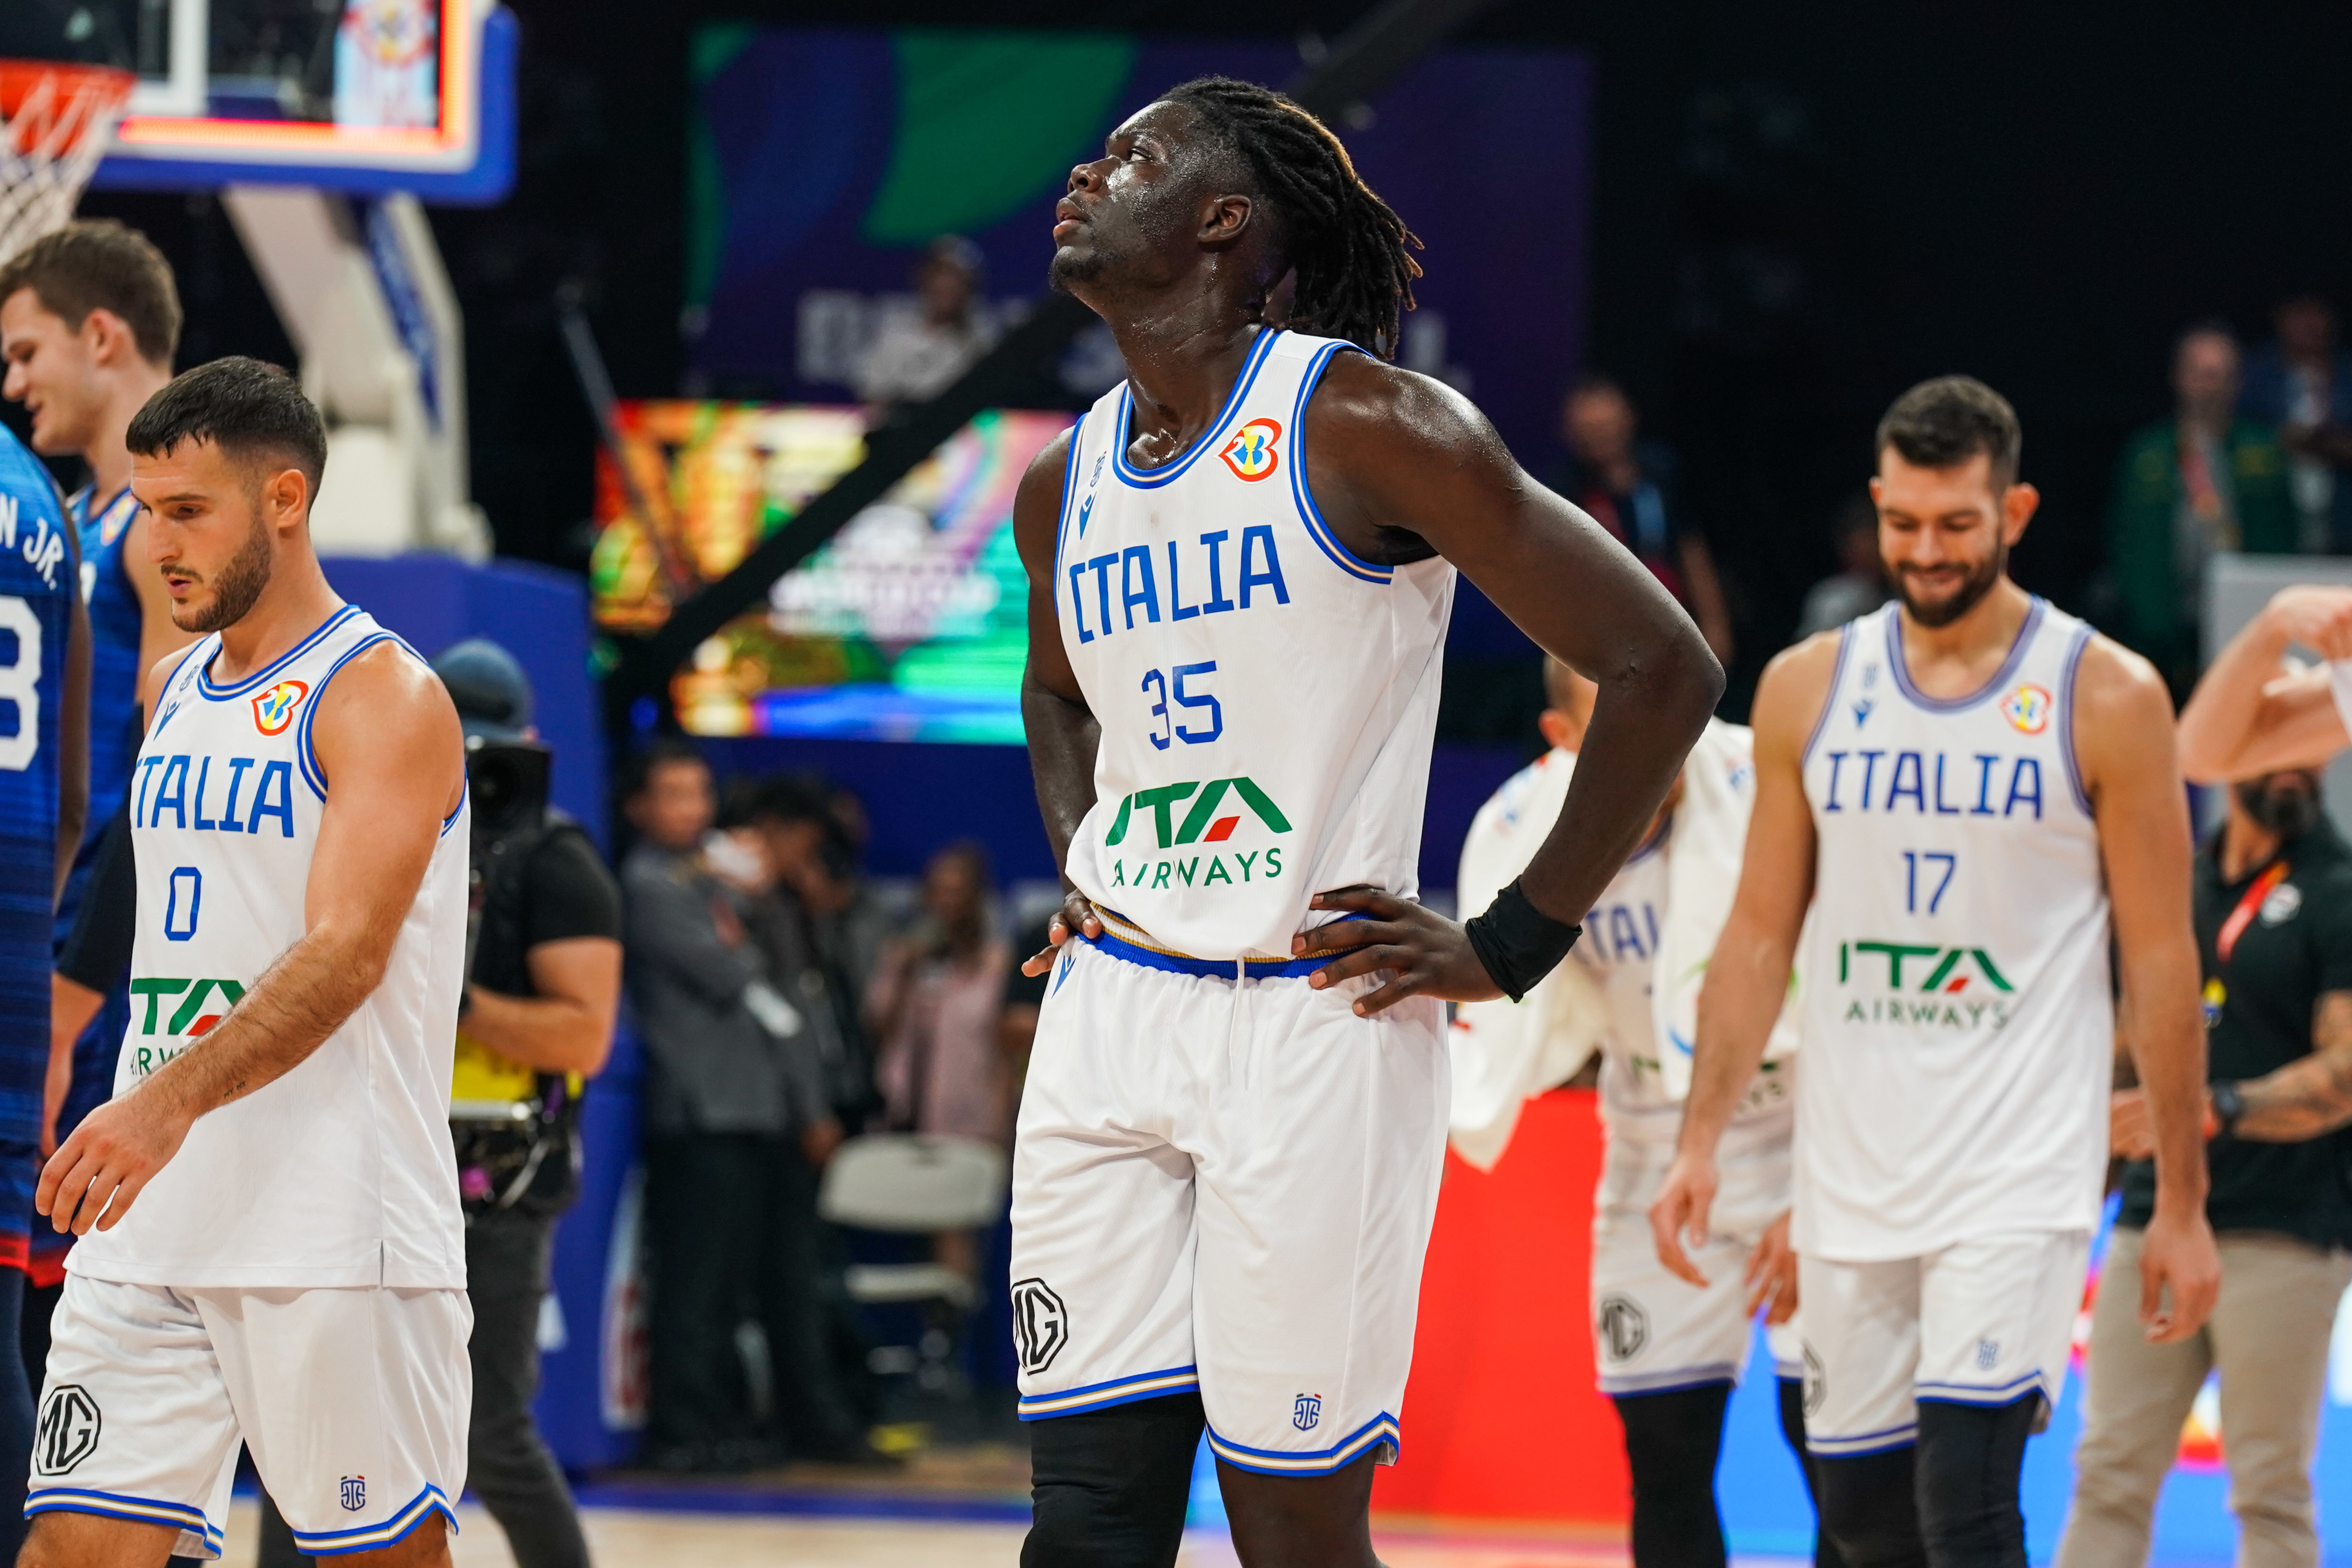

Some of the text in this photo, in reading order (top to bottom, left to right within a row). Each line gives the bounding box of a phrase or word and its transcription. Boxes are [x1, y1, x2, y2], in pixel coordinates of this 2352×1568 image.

[23, 516, 64, 591] JR.
[1069, 524, 1290, 644] ITALIA
[1142, 660, 1223, 751] 35
[1106, 777, 1293, 849] ITA
[1825, 751, 2043, 821] ITALIA
[1110, 847, 1282, 889] AIRWAYS
[1903, 852, 1957, 915] 17
[1840, 942, 2016, 993] ITA
[1843, 998, 2010, 1031] AIRWAYS
[38, 1393, 93, 1469] MG
